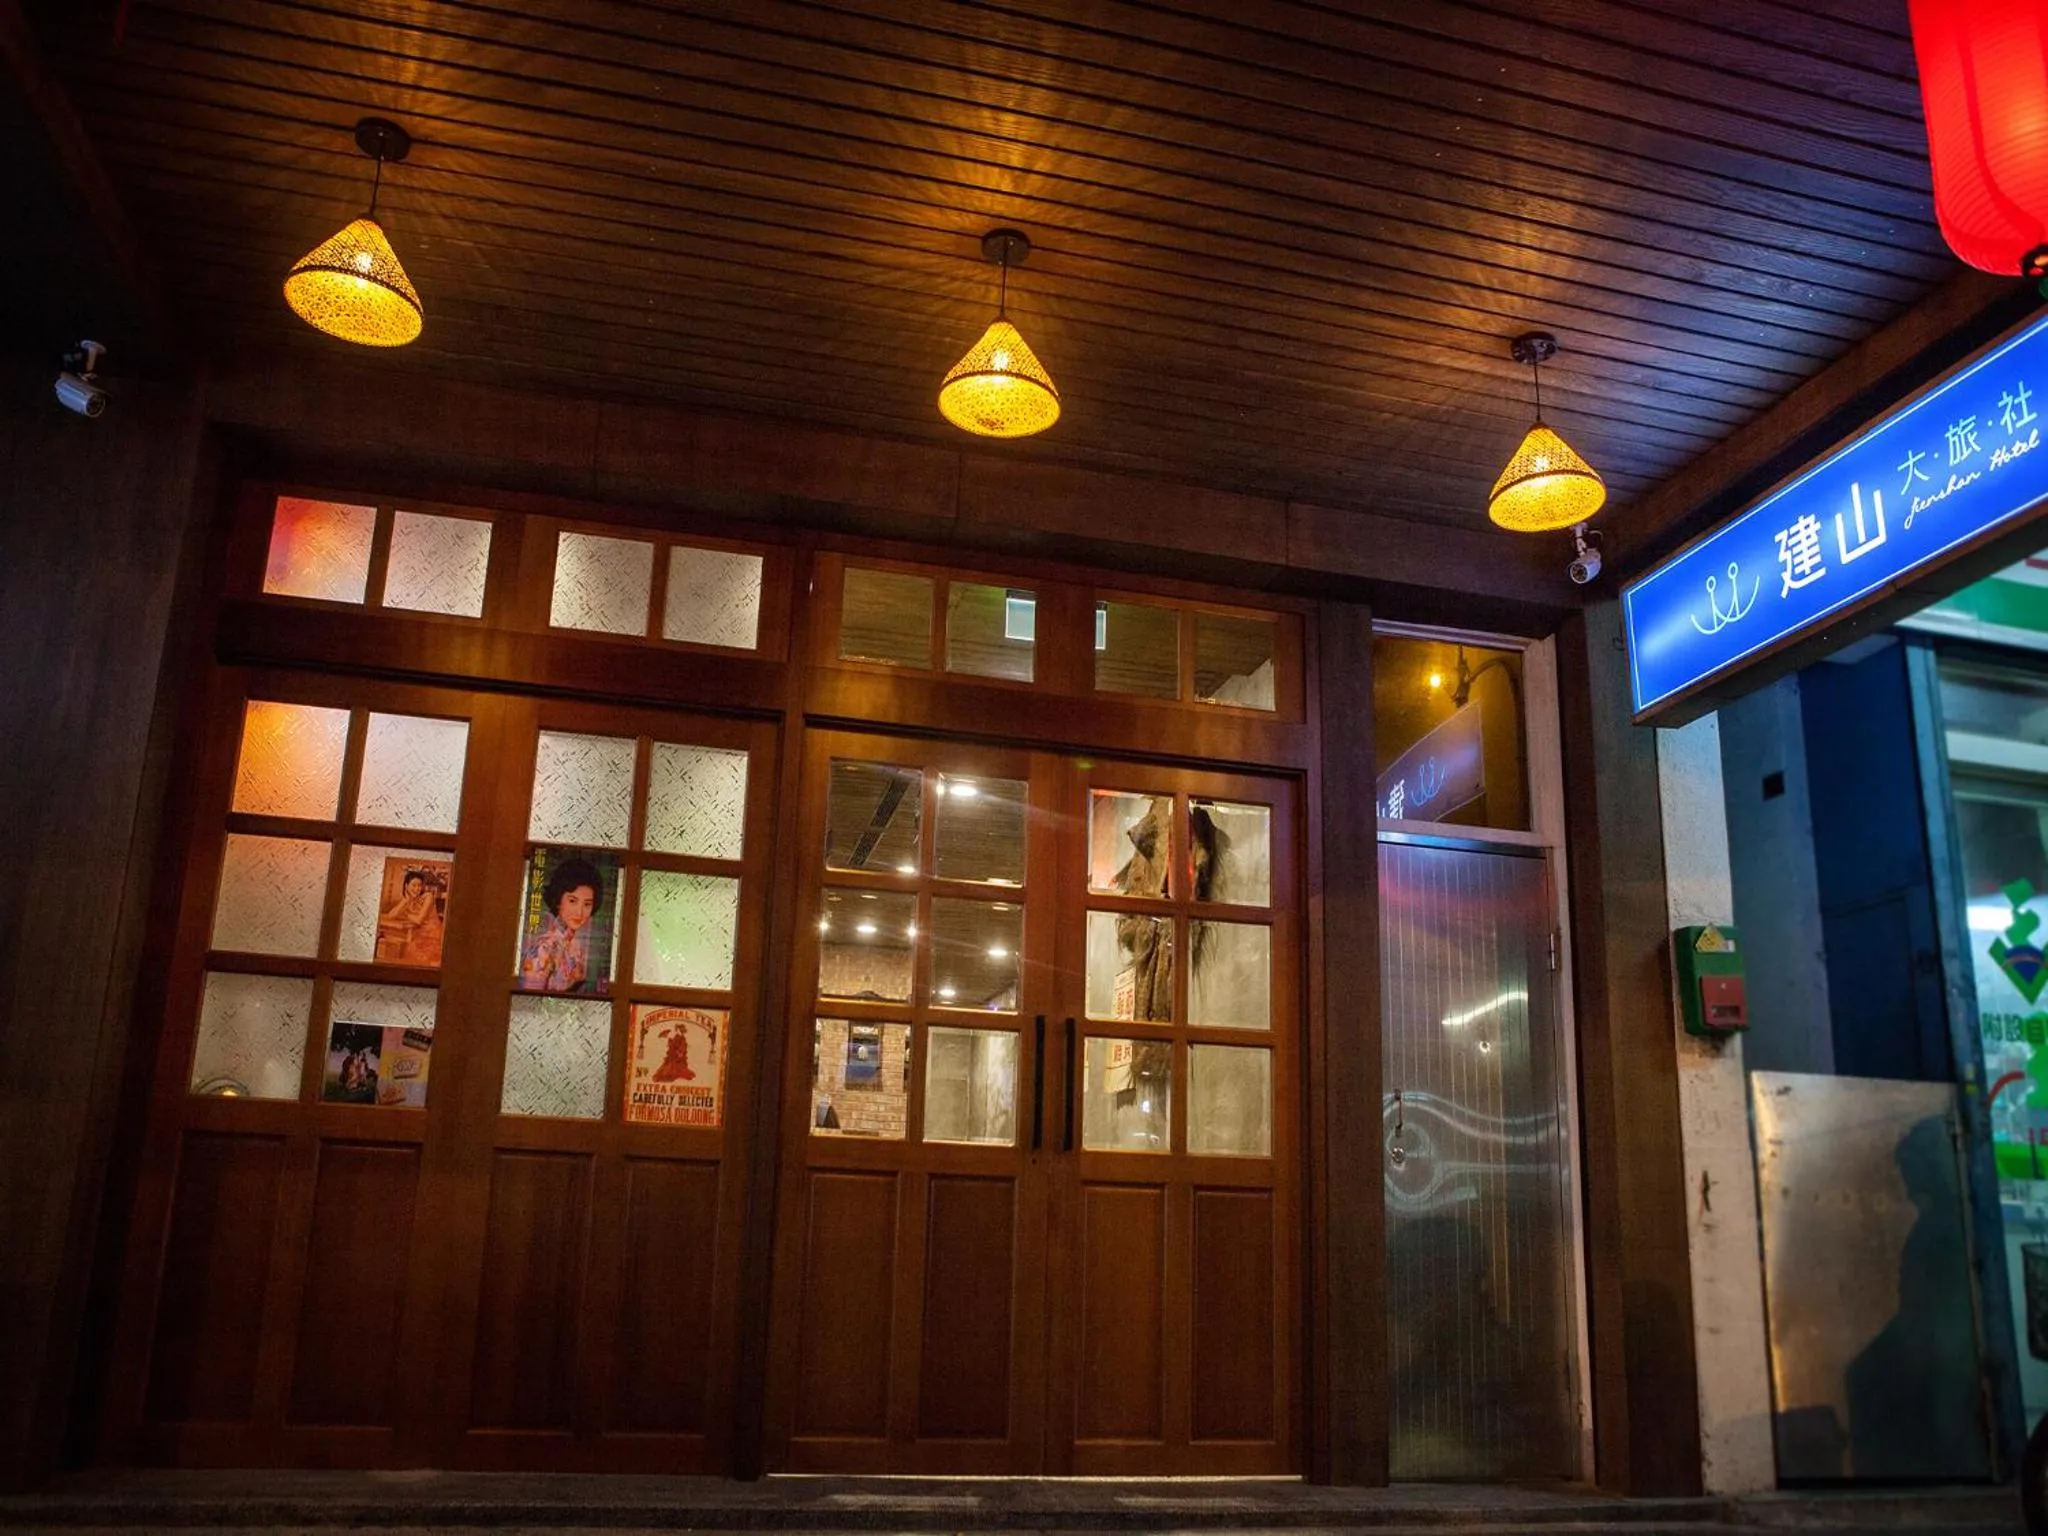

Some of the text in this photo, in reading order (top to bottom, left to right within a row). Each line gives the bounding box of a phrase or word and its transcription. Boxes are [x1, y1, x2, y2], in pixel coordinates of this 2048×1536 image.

[1989, 428, 2040, 472] Hotel
[1774, 481, 1887, 599] 建山
[645, 1008, 713, 1029] IMPERIAL TEA
[636, 1082, 667, 1093] EXTRA
[633, 1092, 714, 1108] CAREFULLY SELECTED
[629, 1104, 672, 1122] FORMOSA
